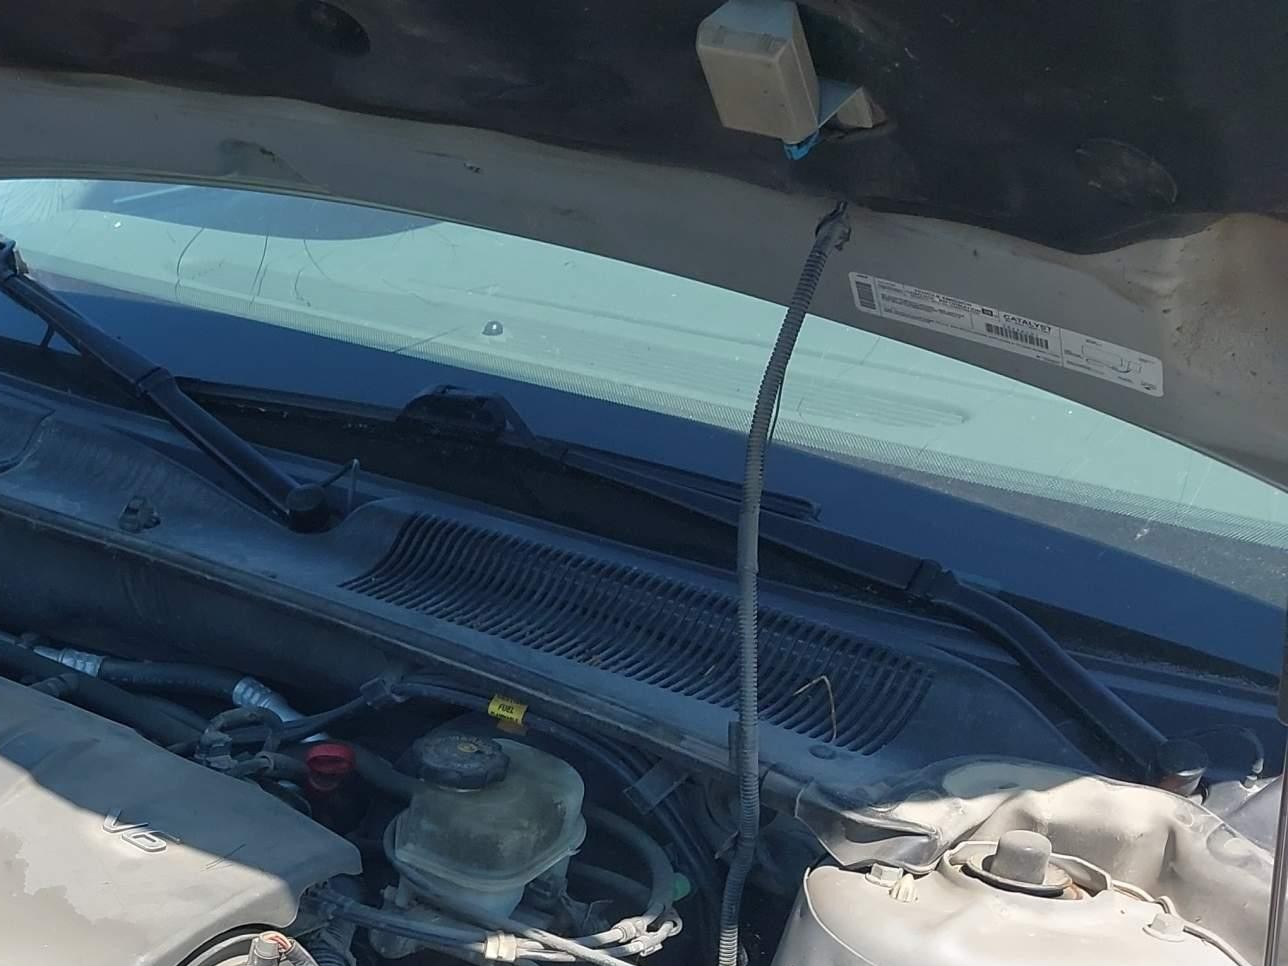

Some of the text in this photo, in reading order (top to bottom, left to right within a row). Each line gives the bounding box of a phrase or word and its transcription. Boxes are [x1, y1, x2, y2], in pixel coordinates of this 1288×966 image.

[1003, 313, 1052, 334] CATALYST
[497, 703, 514, 714] FUEL
[103, 807, 182, 852] V6
